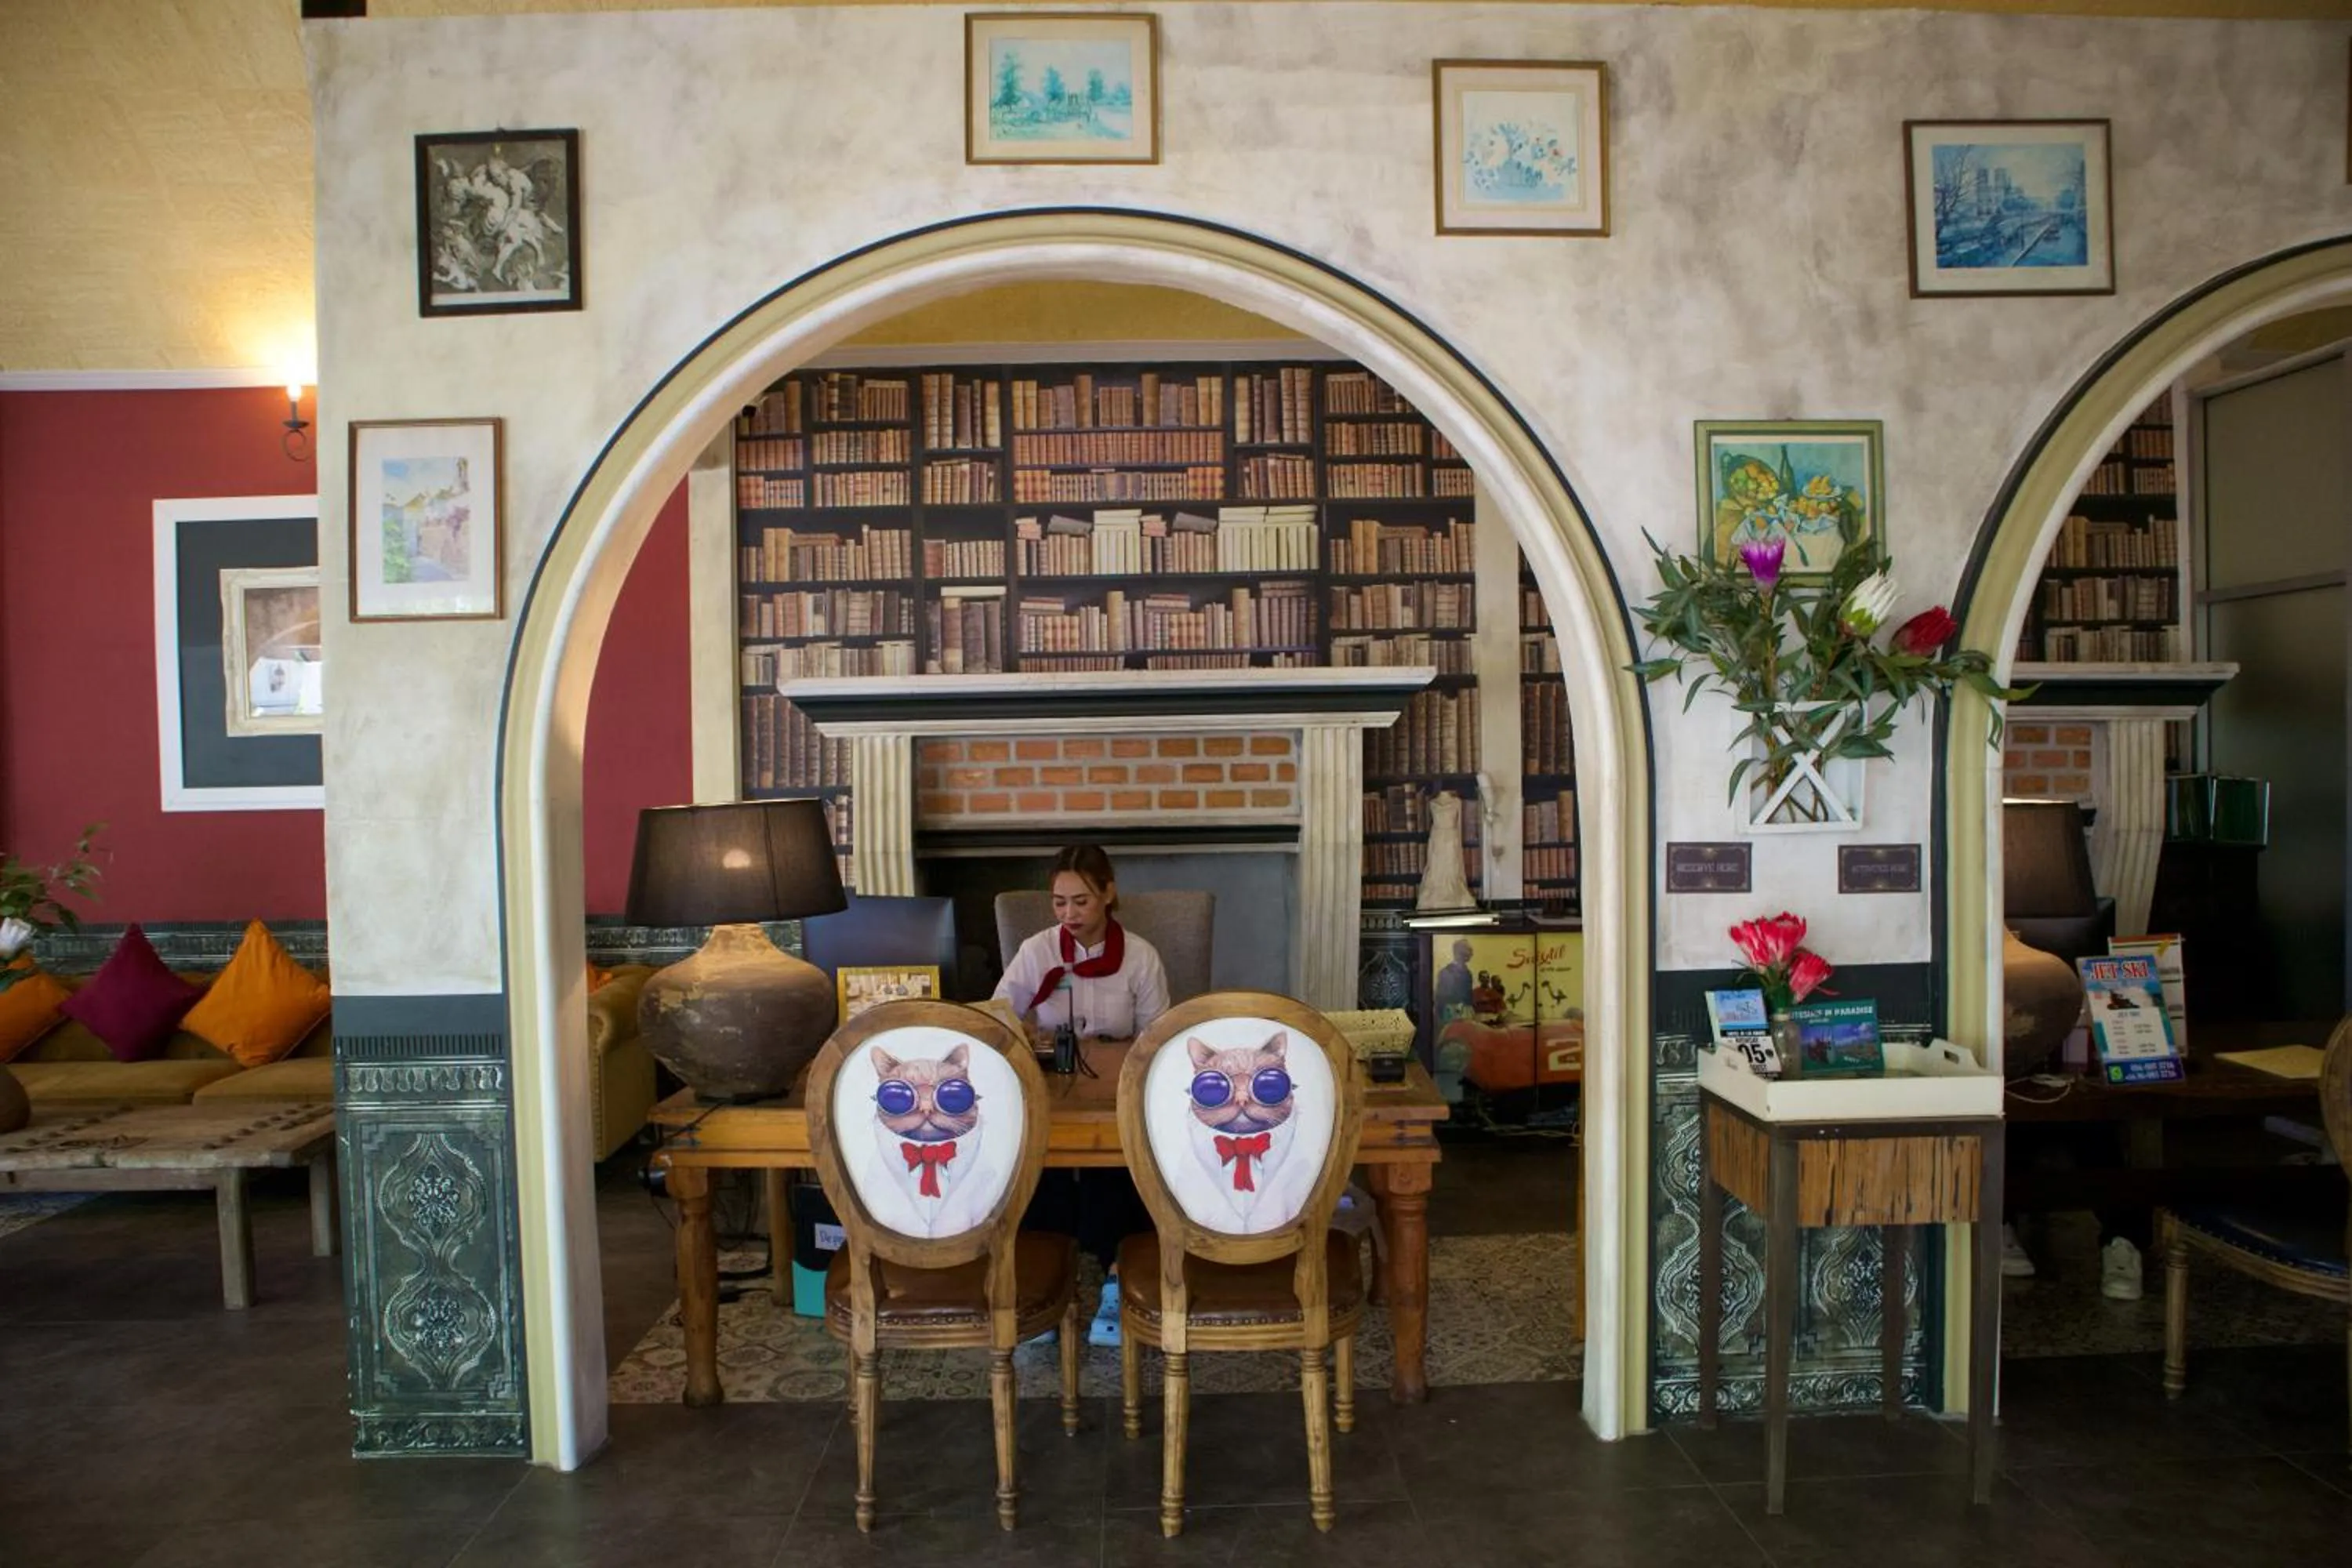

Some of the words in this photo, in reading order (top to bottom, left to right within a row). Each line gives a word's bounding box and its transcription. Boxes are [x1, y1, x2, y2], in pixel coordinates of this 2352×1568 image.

[2090, 962, 2117, 979] JET
[2122, 960, 2147, 978] SKI
[1834, 1006, 1873, 1017] PARADISE
